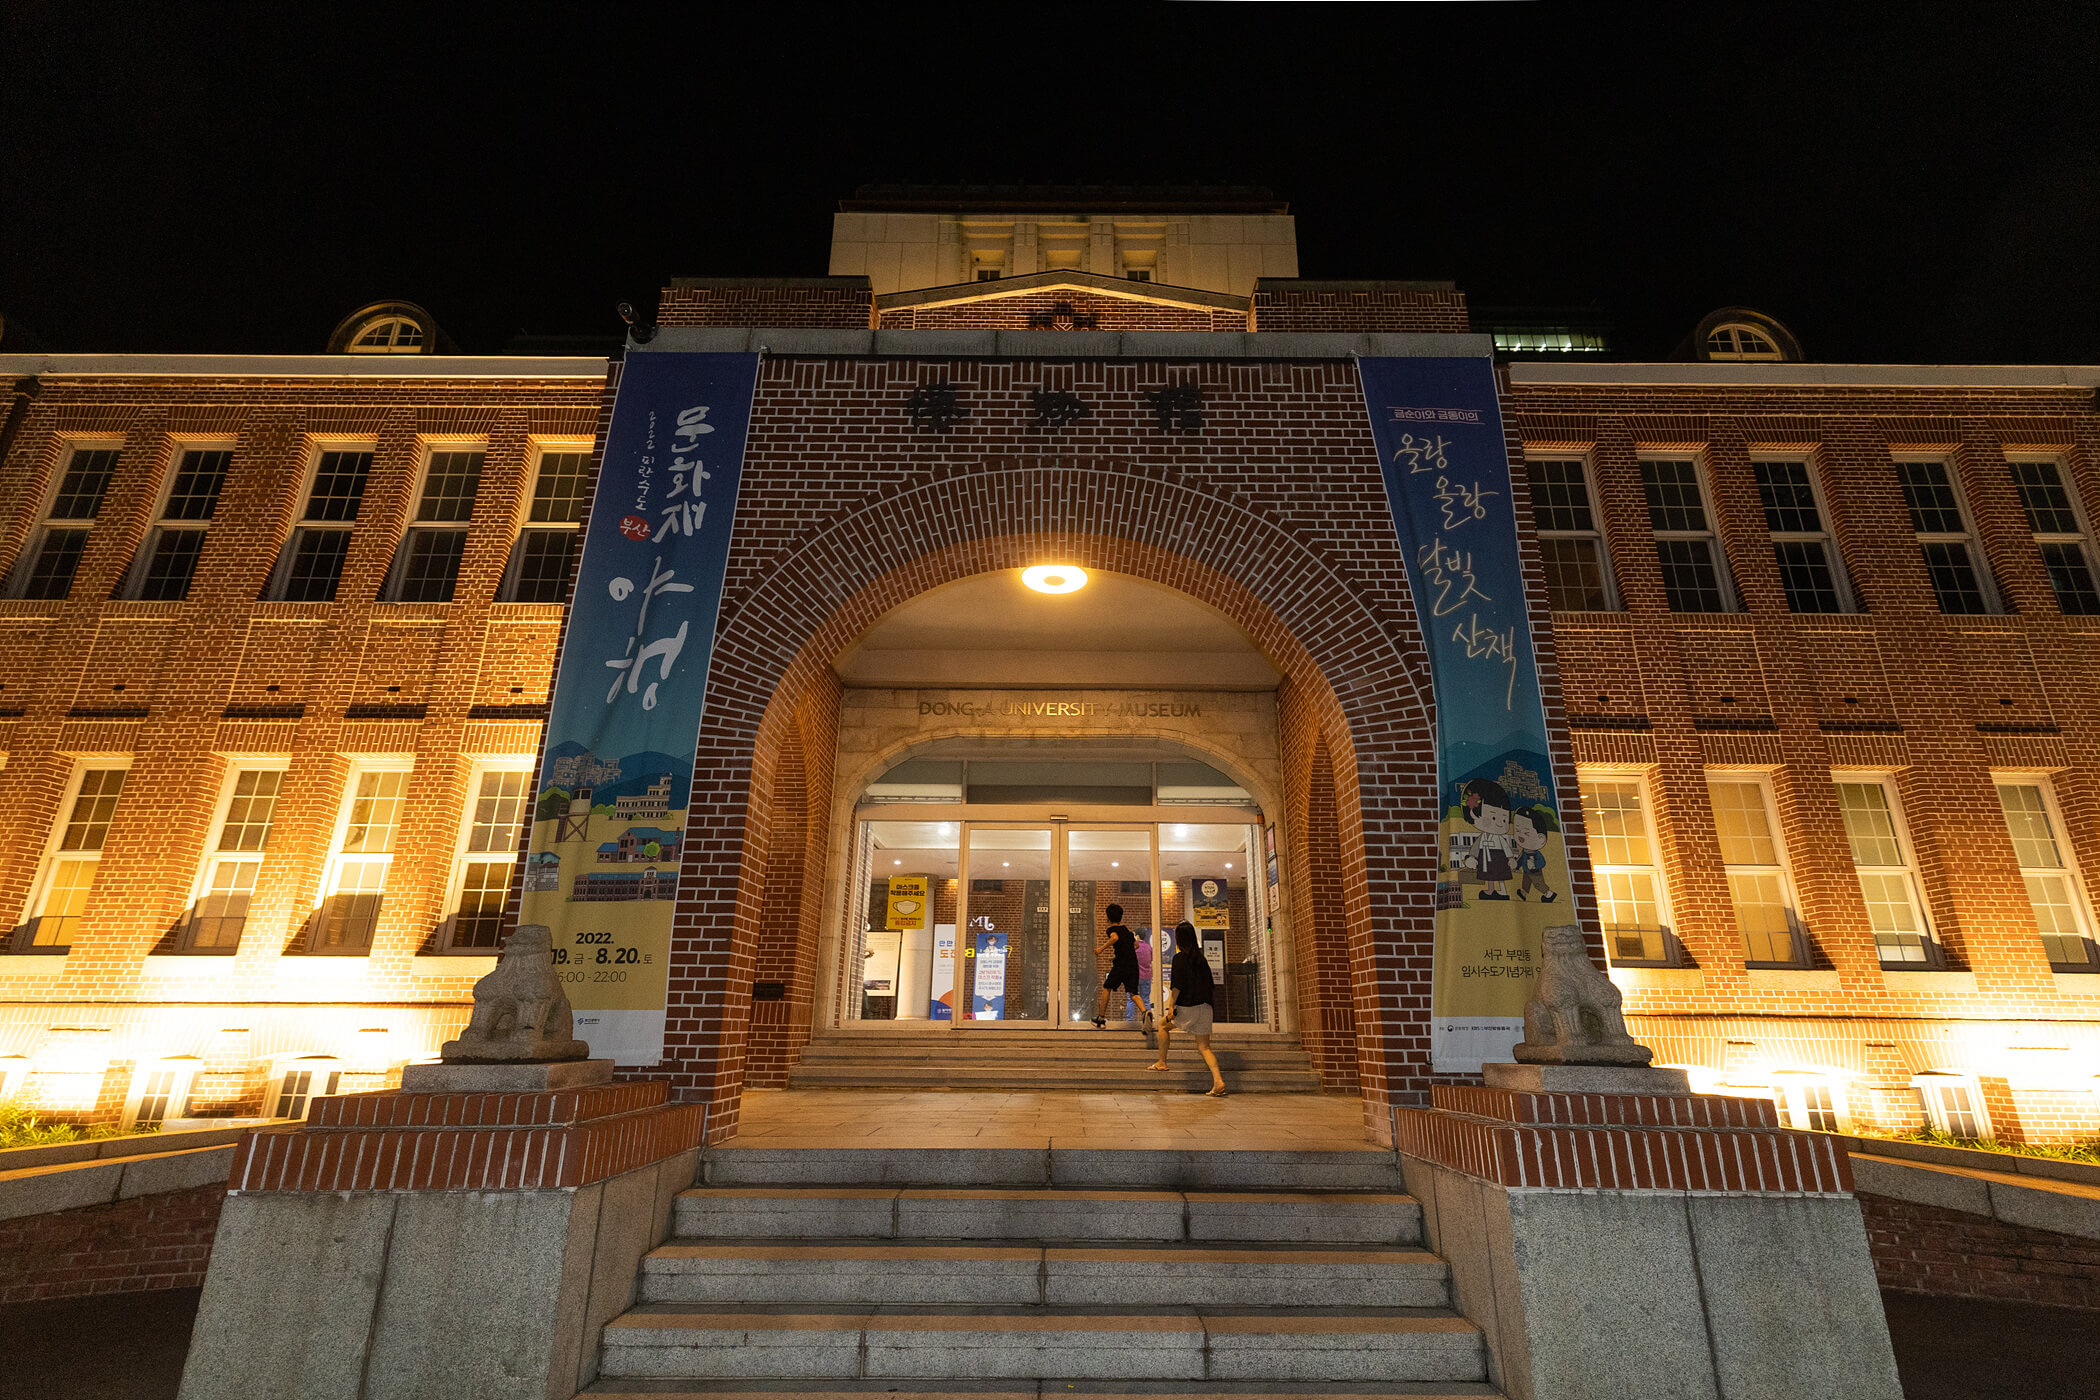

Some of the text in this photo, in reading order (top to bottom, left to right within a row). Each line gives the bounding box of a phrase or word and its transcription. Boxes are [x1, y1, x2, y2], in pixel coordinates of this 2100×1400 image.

[1394, 409, 1479, 422] 금순이와 금동이의
[1393, 433, 1452, 474] 올랑
[620, 411, 656, 538] 2022 피란수도 부산
[1433, 475, 1500, 530] 올랑
[605, 406, 715, 711] 문화재 야행
[1452, 613, 1519, 711] 산책
[1001, 701, 1113, 717] UNIVERSITY
[1118, 702, 1201, 718] MUSEUM
[576, 933, 614, 944] 2022.
[574, 953, 585, 965] 금
[643, 953, 653, 965] 토
[1484, 949, 1531, 961] 서구 부민동
[555, 971, 585, 983] 6:00
[593, 971, 627, 983] 22:00
[1461, 965, 1534, 979] 임시수도기념거리
